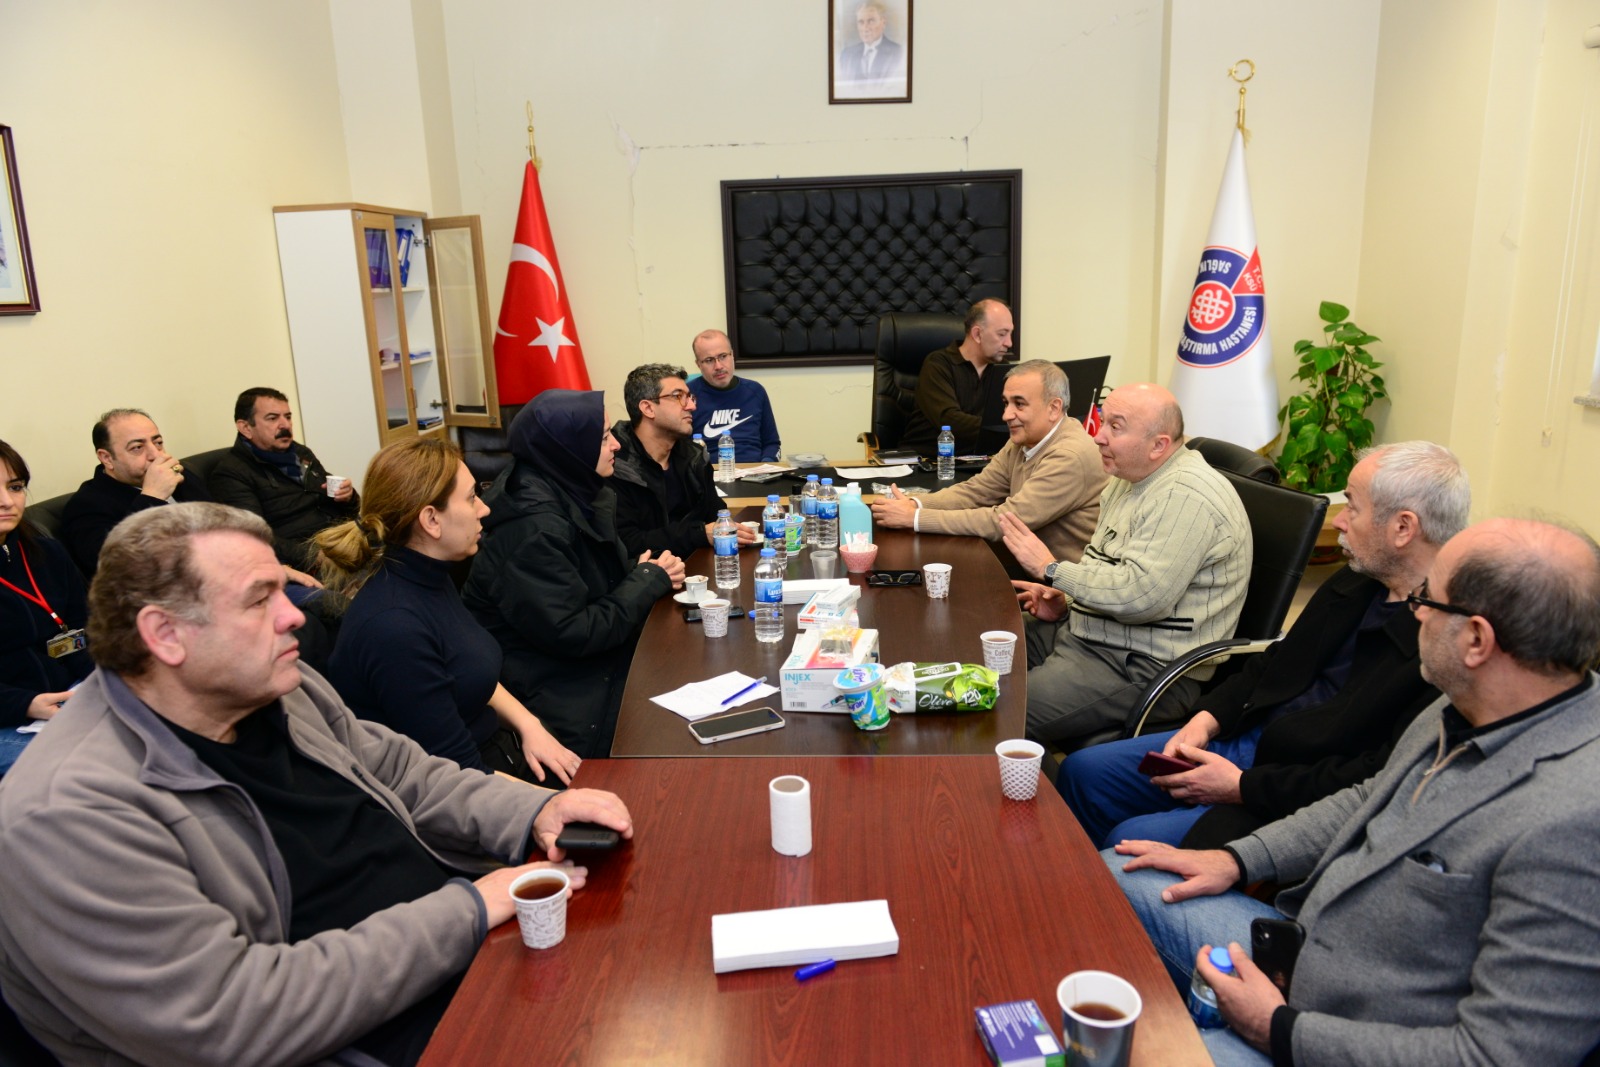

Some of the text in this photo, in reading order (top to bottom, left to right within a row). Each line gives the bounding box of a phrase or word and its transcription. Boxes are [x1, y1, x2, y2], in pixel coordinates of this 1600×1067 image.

[1181, 333, 1218, 355] AŞTIRMA
[710, 409, 740, 425] NIKE
[918, 693, 953, 707] Olive
[961, 688, 982, 704] 120
